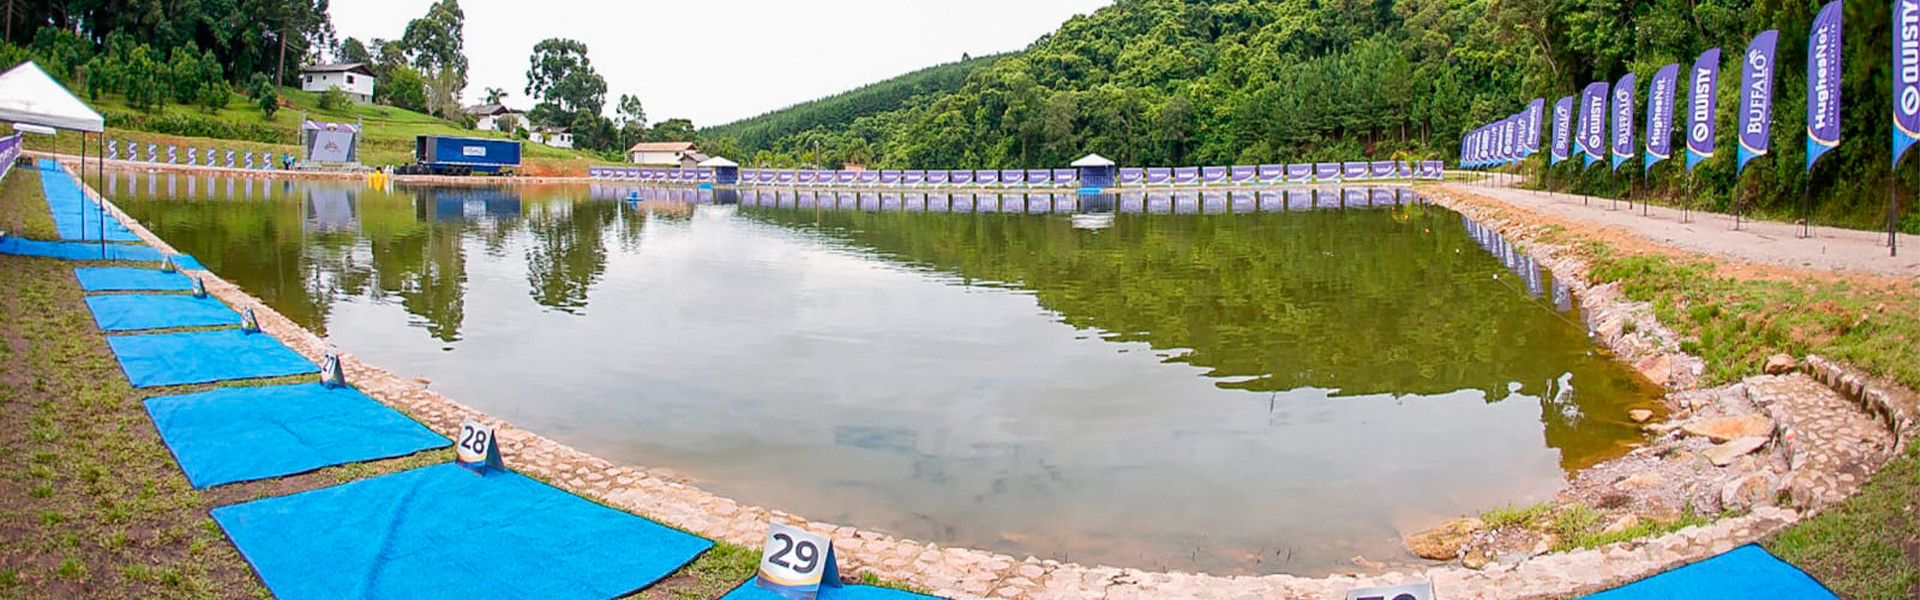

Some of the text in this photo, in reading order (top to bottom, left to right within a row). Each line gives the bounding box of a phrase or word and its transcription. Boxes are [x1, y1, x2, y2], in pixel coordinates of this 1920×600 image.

[1901, 0, 1919, 83] QUISTY
[1694, 68, 1711, 121] QUISTY
[1747, 54, 1767, 134] BUFFALO
[1815, 24, 1829, 129] HughesNet
[1590, 95, 1602, 134] QUISTY
[1618, 90, 1631, 146] BUFFALO
[1651, 79, 1665, 146] HughesNet
[323, 354, 334, 374] 27
[461, 425, 486, 454] 28
[768, 533, 819, 574] 29
